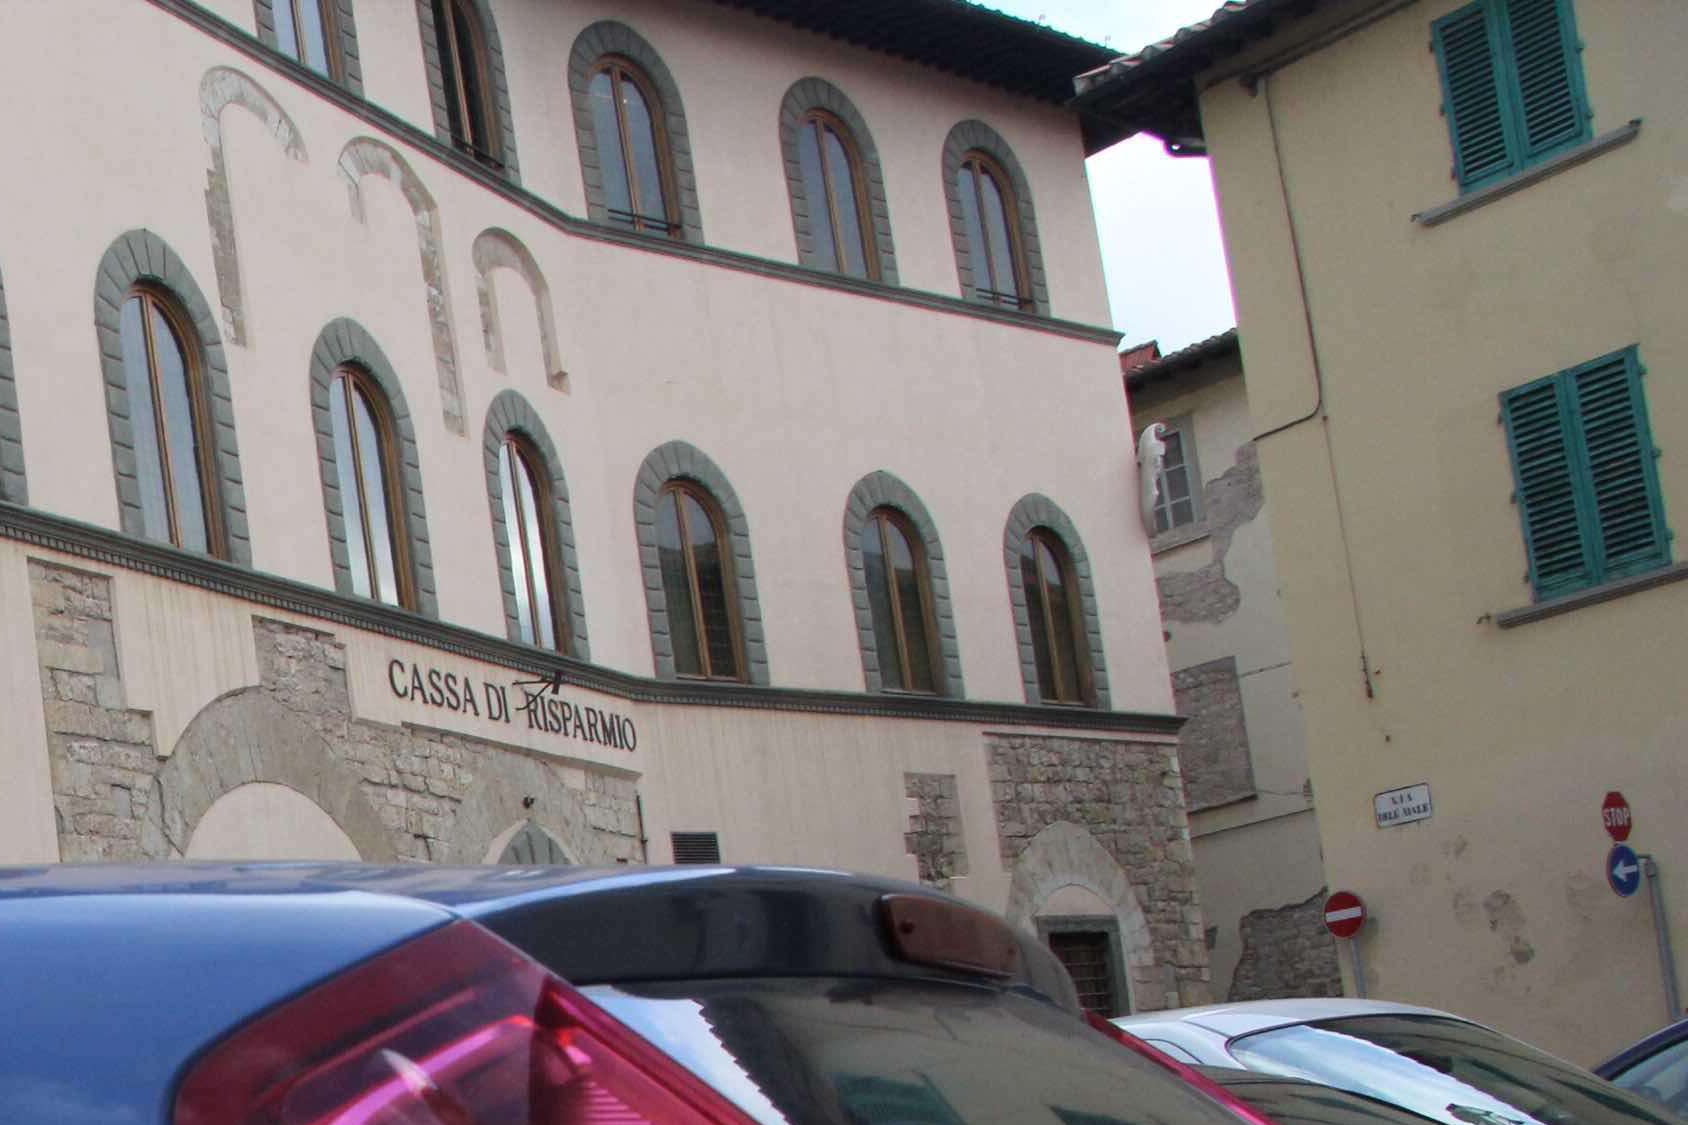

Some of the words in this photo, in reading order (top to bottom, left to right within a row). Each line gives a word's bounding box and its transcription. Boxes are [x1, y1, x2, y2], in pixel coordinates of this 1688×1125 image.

[388, 659, 480, 717] CASSA
[484, 682, 511, 723] DI
[525, 692, 637, 752] RISPARMIO
[1603, 807, 1630, 827] STOP
